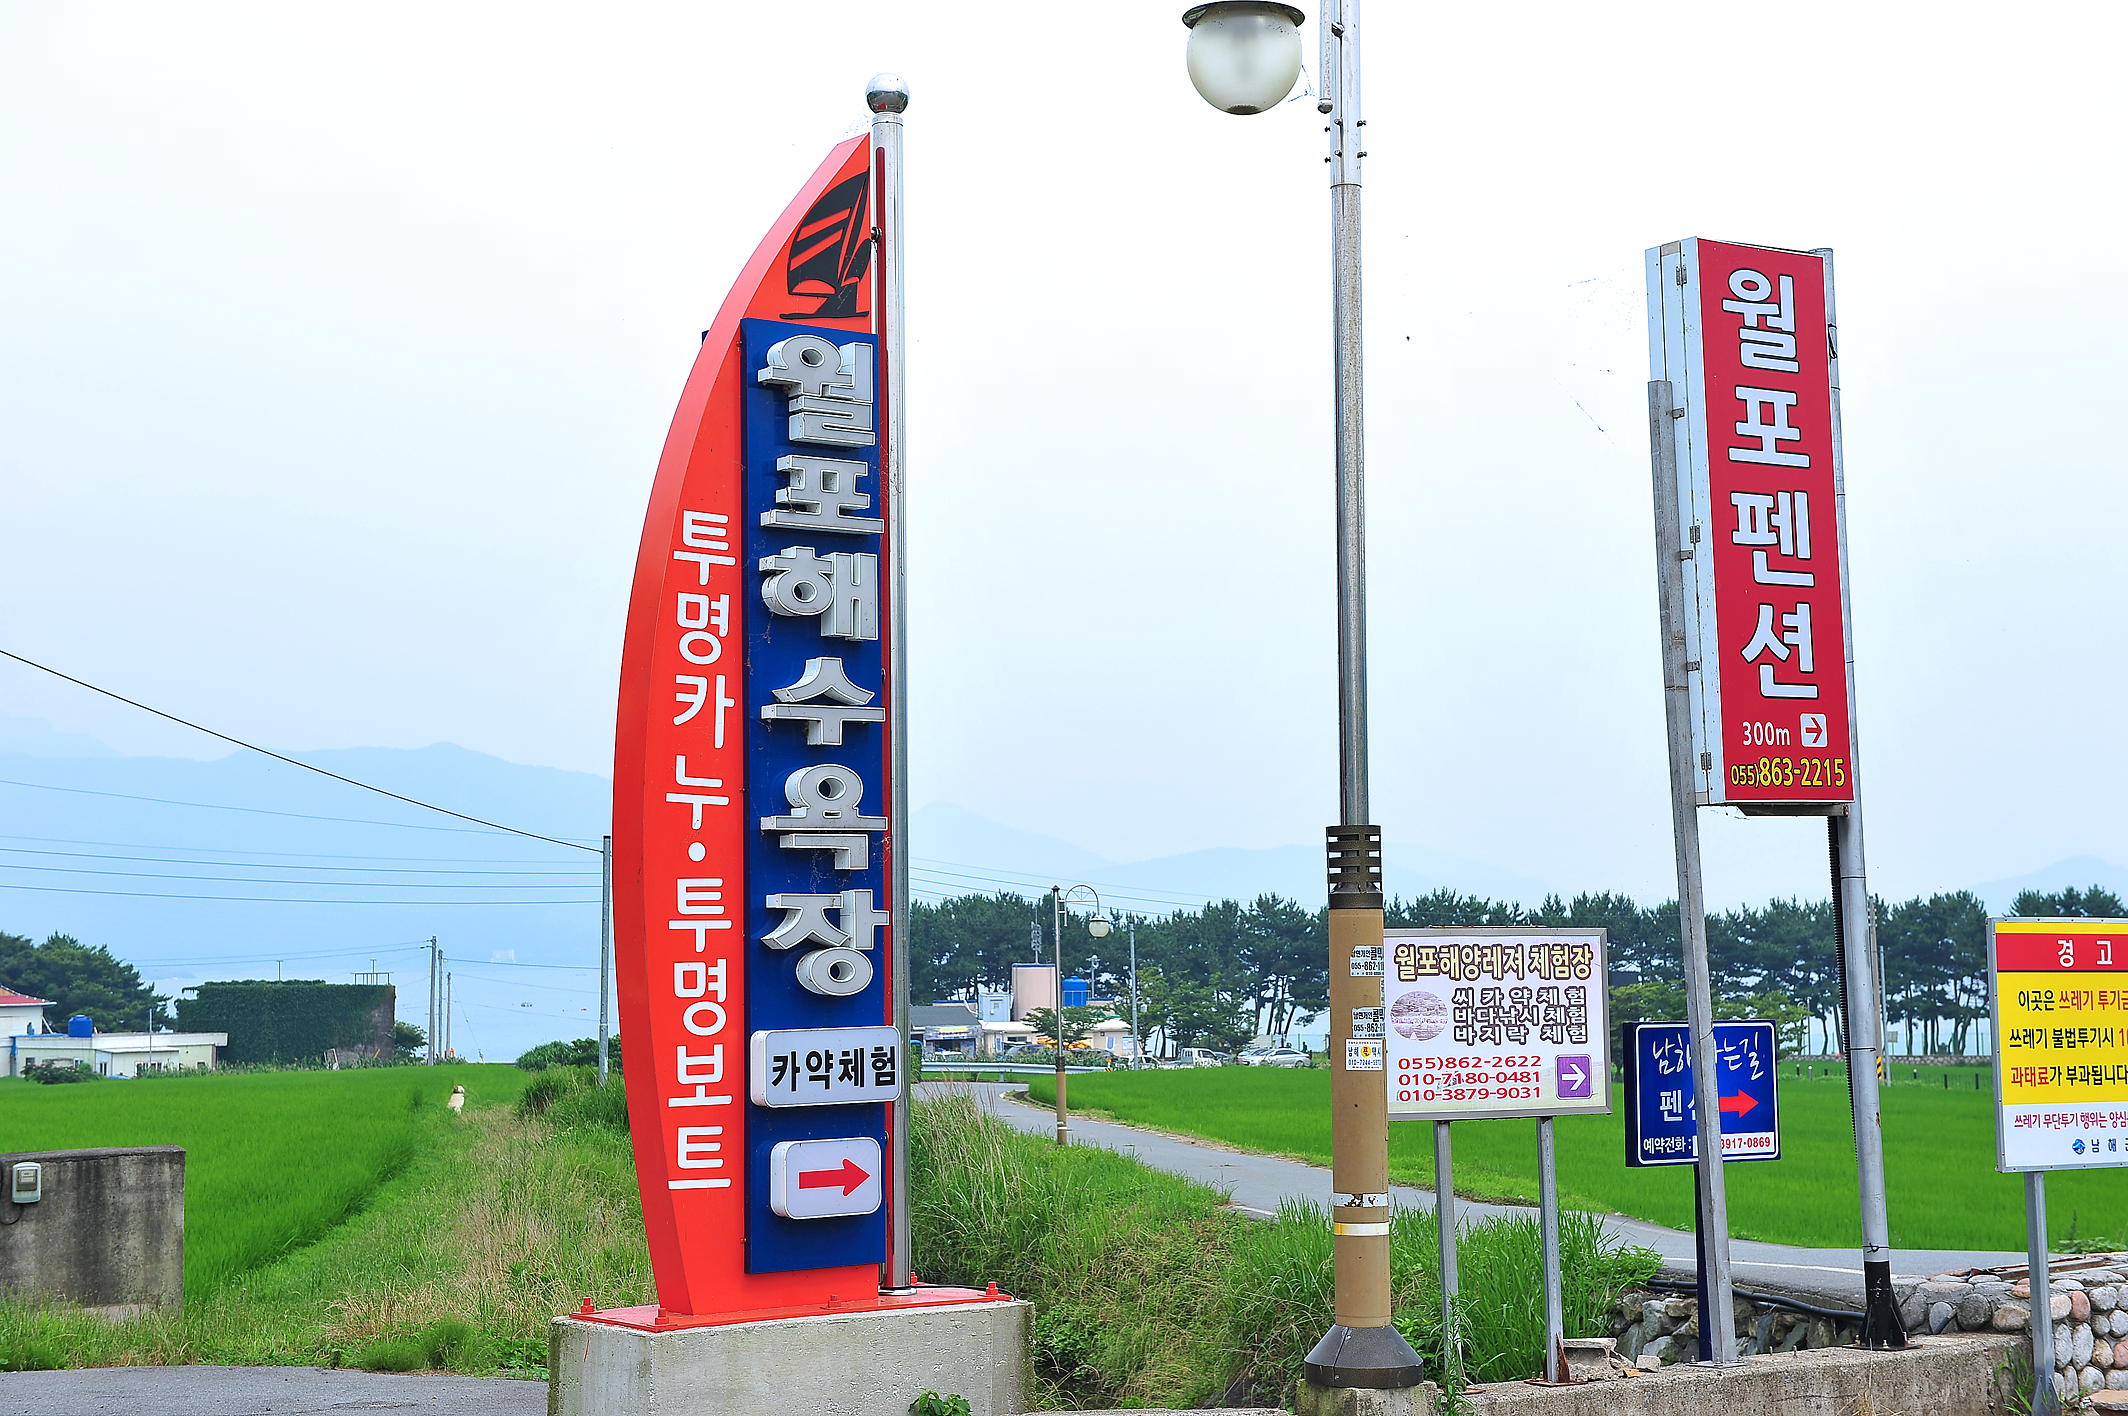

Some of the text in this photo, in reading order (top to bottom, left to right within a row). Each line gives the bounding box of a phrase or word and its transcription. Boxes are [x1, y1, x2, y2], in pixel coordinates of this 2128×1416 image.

[1722, 267, 1819, 699] 월포펜션
[758, 335, 889, 996] 월포해수욕장
[1742, 721, 1791, 746] 300m
[1730, 756, 1846, 788] 055)863-2215
[1395, 943, 1594, 981] 월포해양레져 체험장
[2018, 990, 2055, 1011] 이곳은
[2059, 990, 2094, 1011] 쓰레기
[1453, 1005, 1588, 1026] 바다낚시 체험
[1453, 1024, 1588, 1046] 바지락 체험
[2009, 1028, 2048, 1049] 쓰레기
[2051, 1027, 2114, 1049] 불법투기시
[771, 1045, 896, 1091] 카약체험
[1398, 1055, 1542, 1071] 055)862-2622
[1398, 1071, 1541, 1086] 010-7180-0481
[2011, 1065, 2062, 1088] 과태료가
[1398, 1086, 1541, 1102] 010-3879-9031
[2014, 1113, 2041, 1129] 쓰레기
[2043, 1112, 2079, 1130] 무단투기
[2080, 1111, 2108, 1130] 행위는
